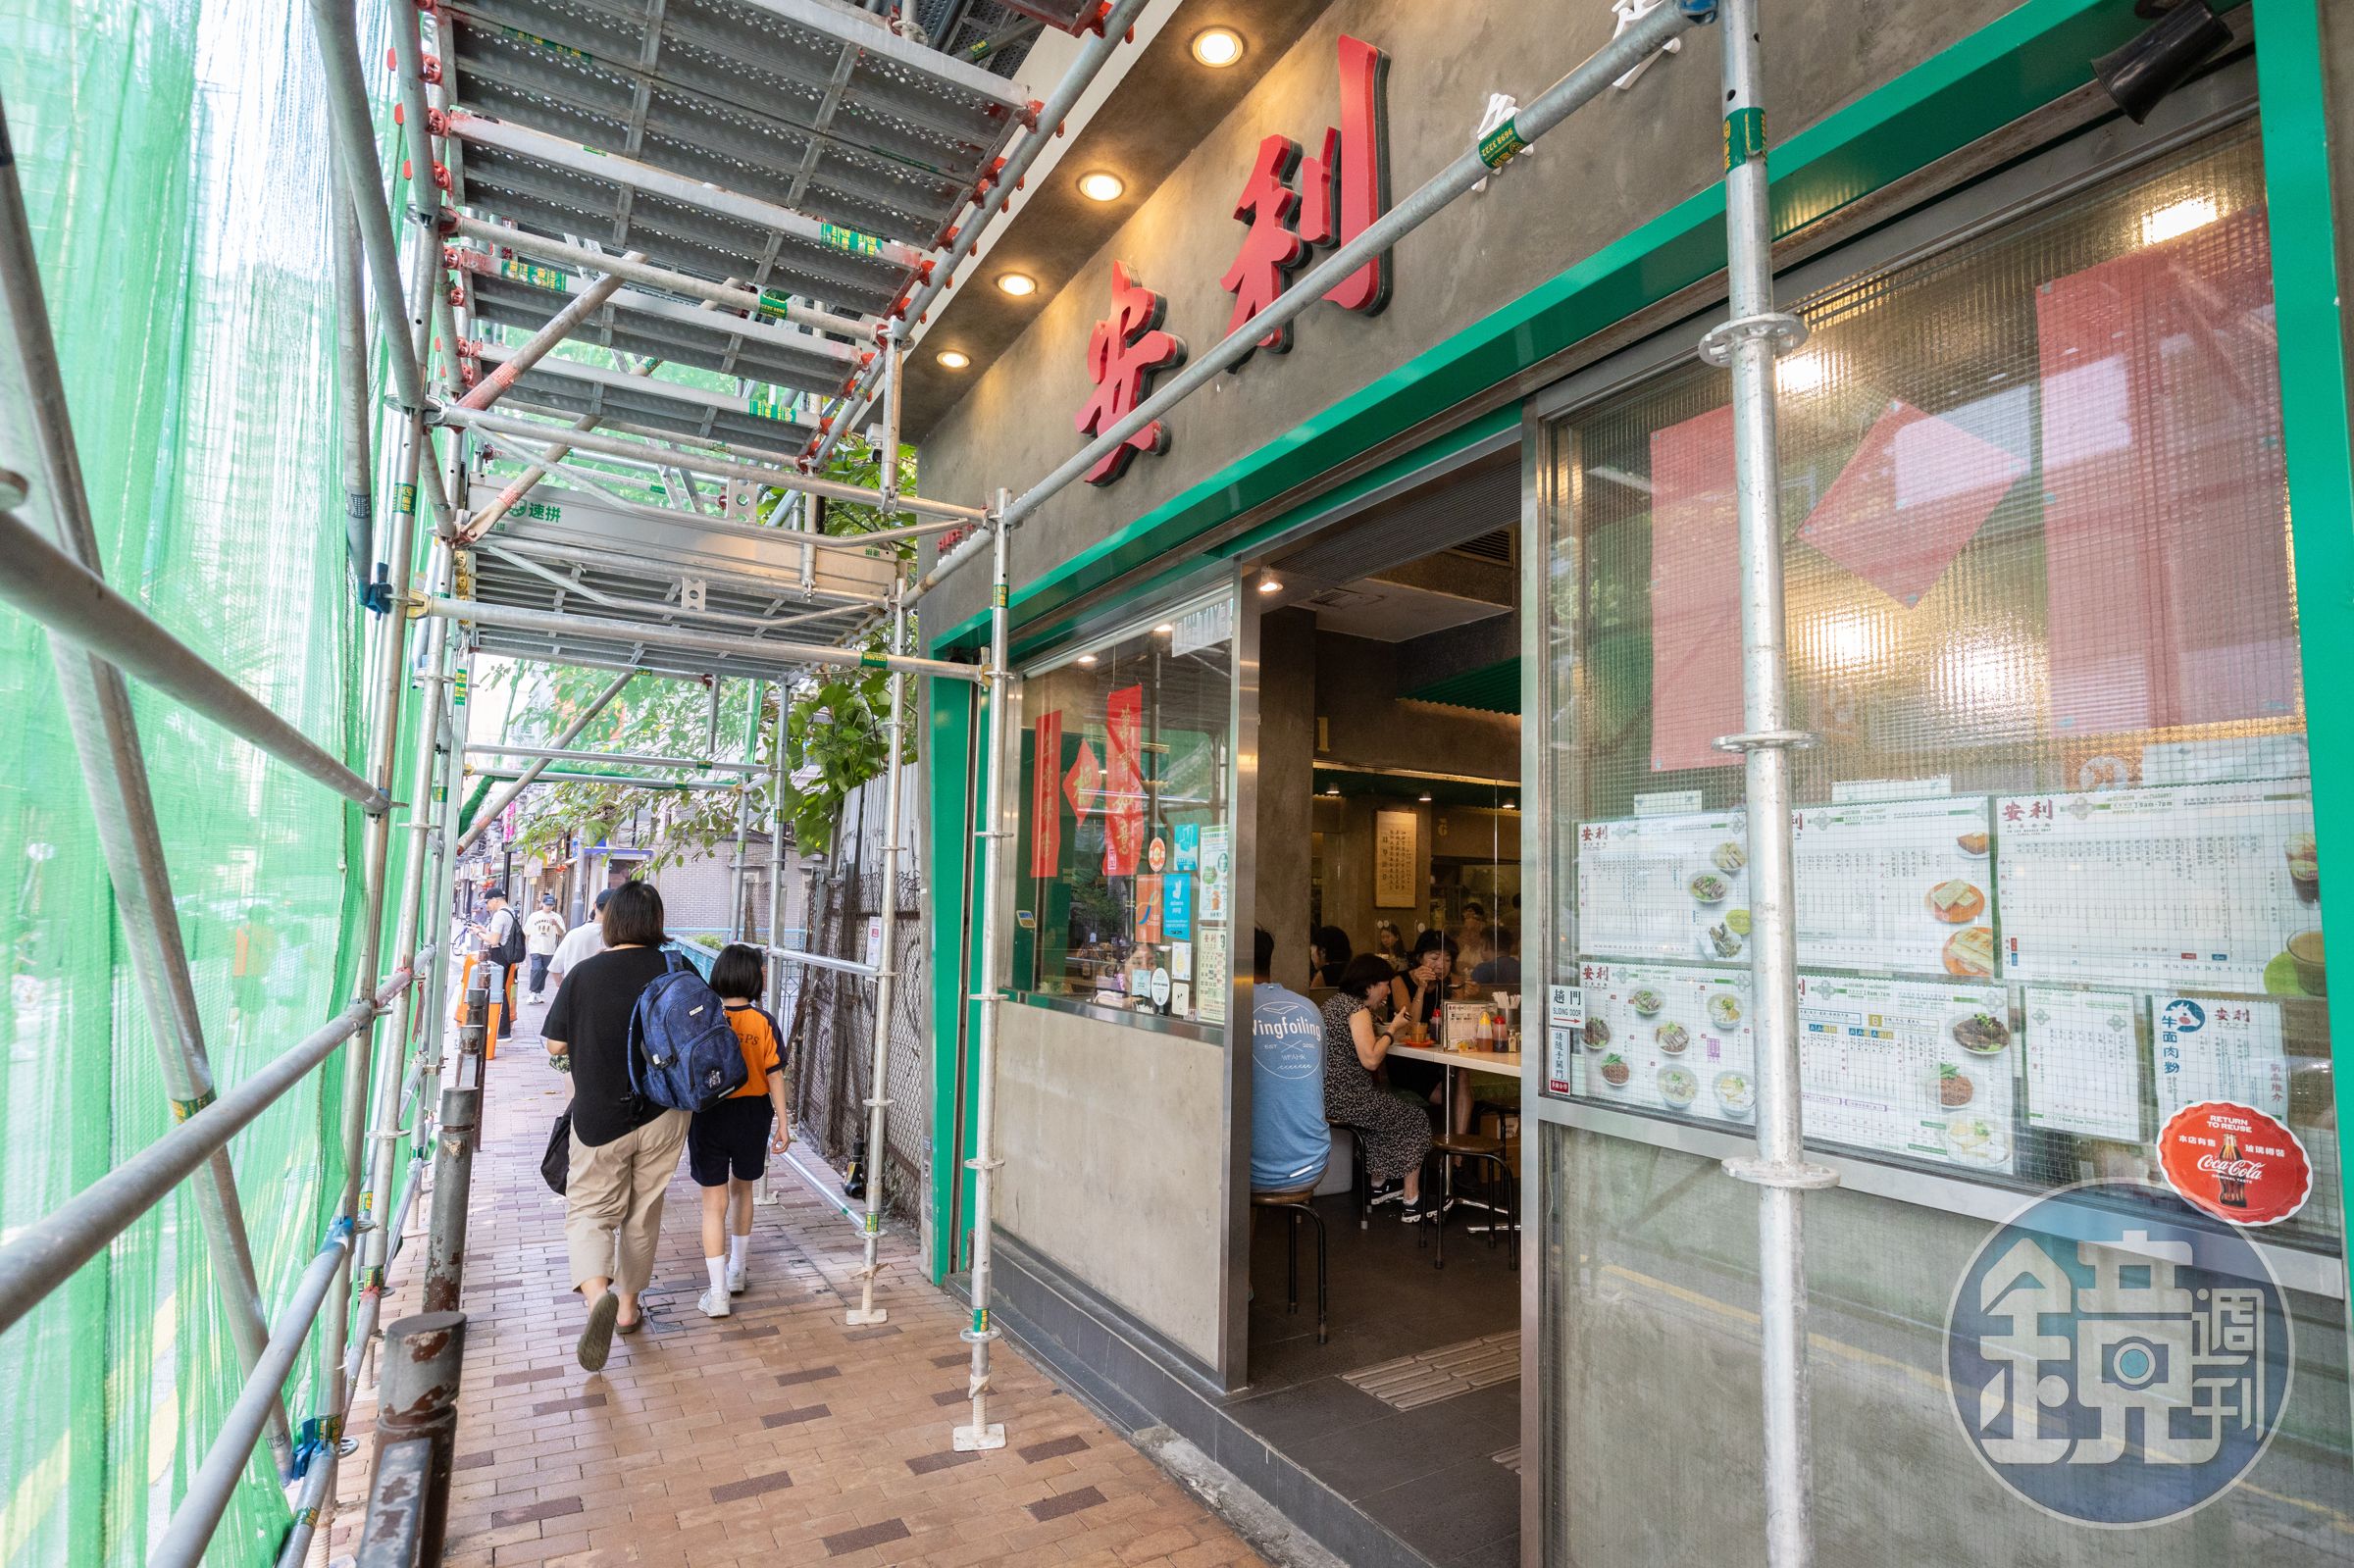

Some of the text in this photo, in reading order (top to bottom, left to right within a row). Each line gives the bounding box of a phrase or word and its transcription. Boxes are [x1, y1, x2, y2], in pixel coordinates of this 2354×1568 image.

[529, 502, 561, 524] 速拼
[2002, 799, 2054, 822] 安利
[1581, 825, 1609, 841] 安利
[1582, 966, 1610, 981] 安利
[1553, 988, 1581, 1006] 趟門
[1553, 1007, 1581, 1017] SLIDING DOOR
[2215, 1006, 2251, 1023] 安利
[2209, 1115, 2249, 1126] RETURN
[2221, 1123, 2253, 1134] REUSE
[2178, 1135, 2217, 1147] 本店有售
[2245, 1144, 2285, 1158] 玻璃樽裝
[2197, 1154, 2266, 1180] Coca-Cola
